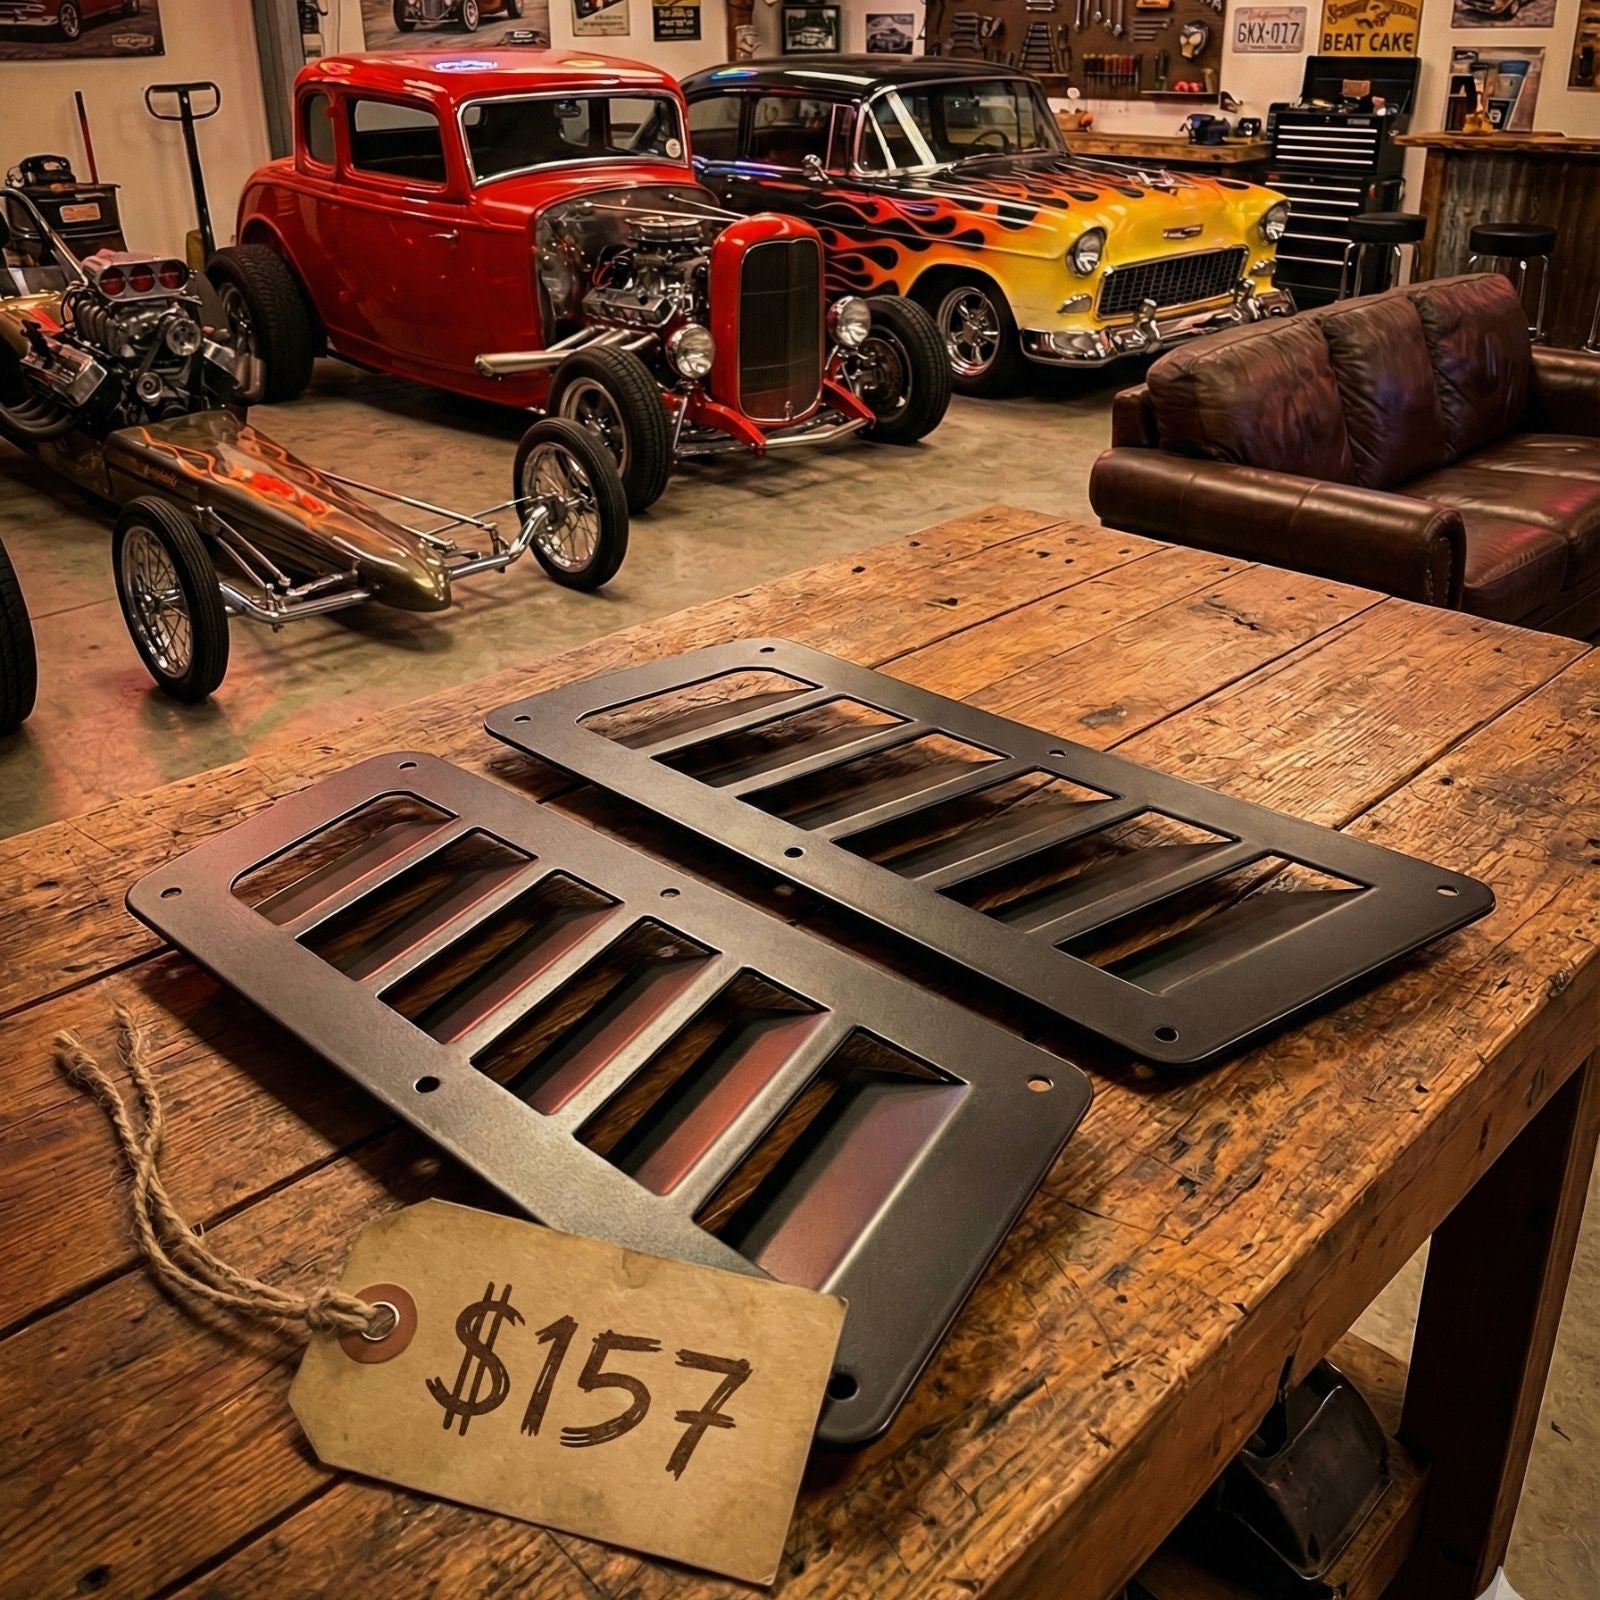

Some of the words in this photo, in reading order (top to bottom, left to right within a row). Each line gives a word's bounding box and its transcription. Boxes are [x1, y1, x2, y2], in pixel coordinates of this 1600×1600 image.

[1323, 33, 1365, 52] BEAT
[1369, 33, 1414, 52] CAKE
[426, 1281, 754, 1482] $157
